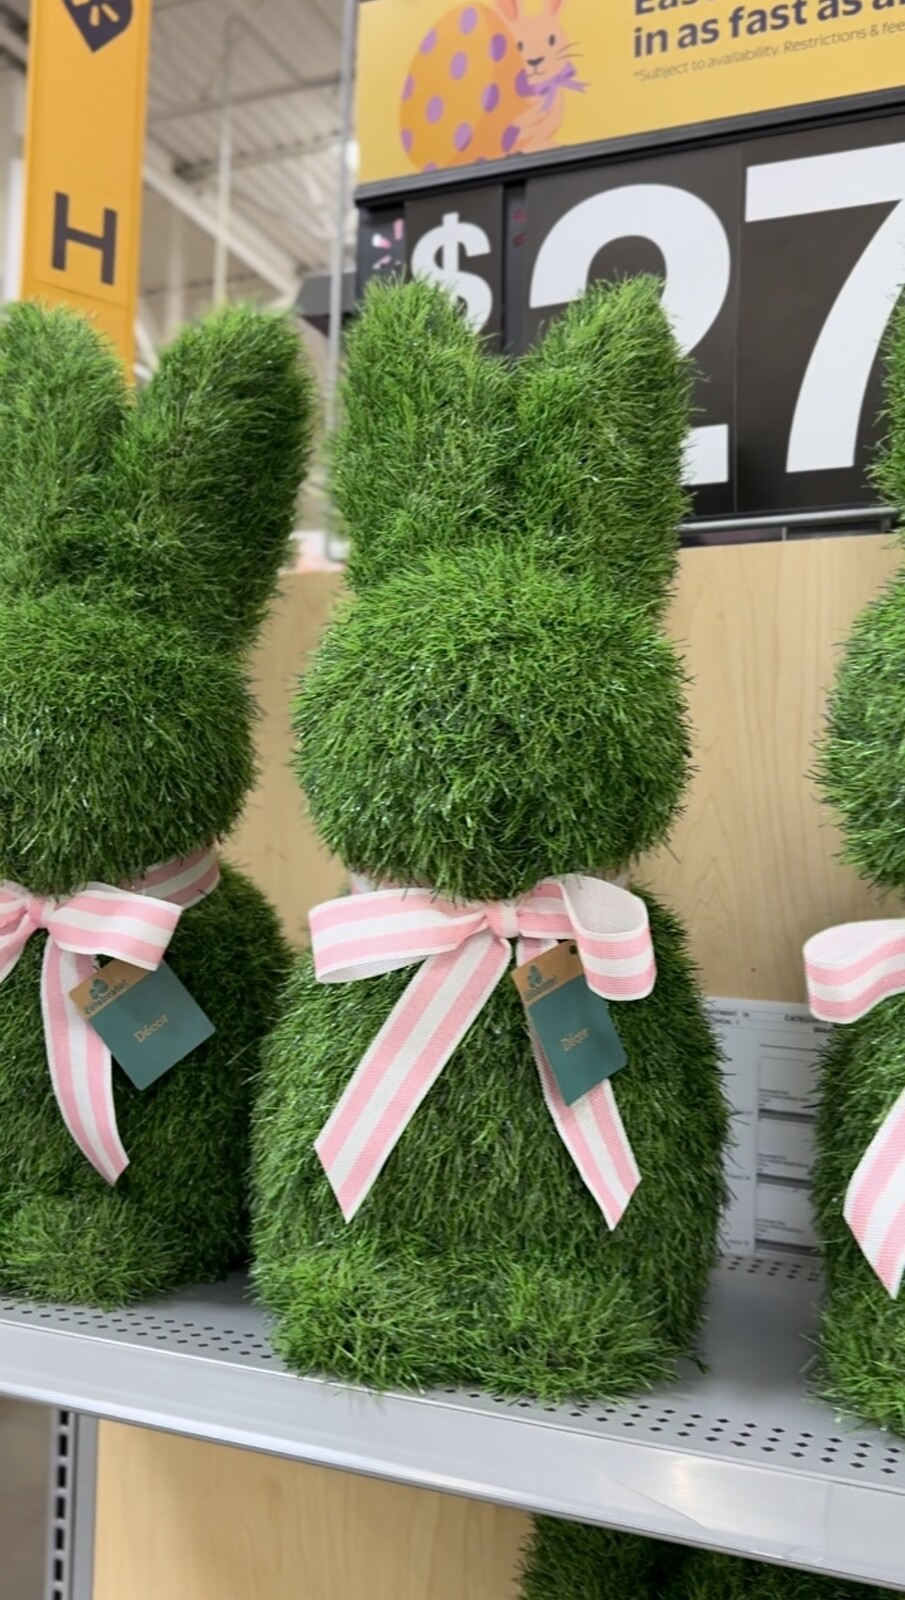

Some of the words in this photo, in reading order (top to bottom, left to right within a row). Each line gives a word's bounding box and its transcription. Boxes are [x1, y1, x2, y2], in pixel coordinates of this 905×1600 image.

[634, 26, 668, 58] in
[677, 18, 719, 49] as
[728, 0, 808, 38] fast
[817, 0, 863, 21] as
[691, 59, 705, 71] to
[783, 27, 867, 53] Restrictions
[869, 24, 879, 37] &
[51, 191, 118, 286] H
[133, 1013, 169, 1043] Décor
